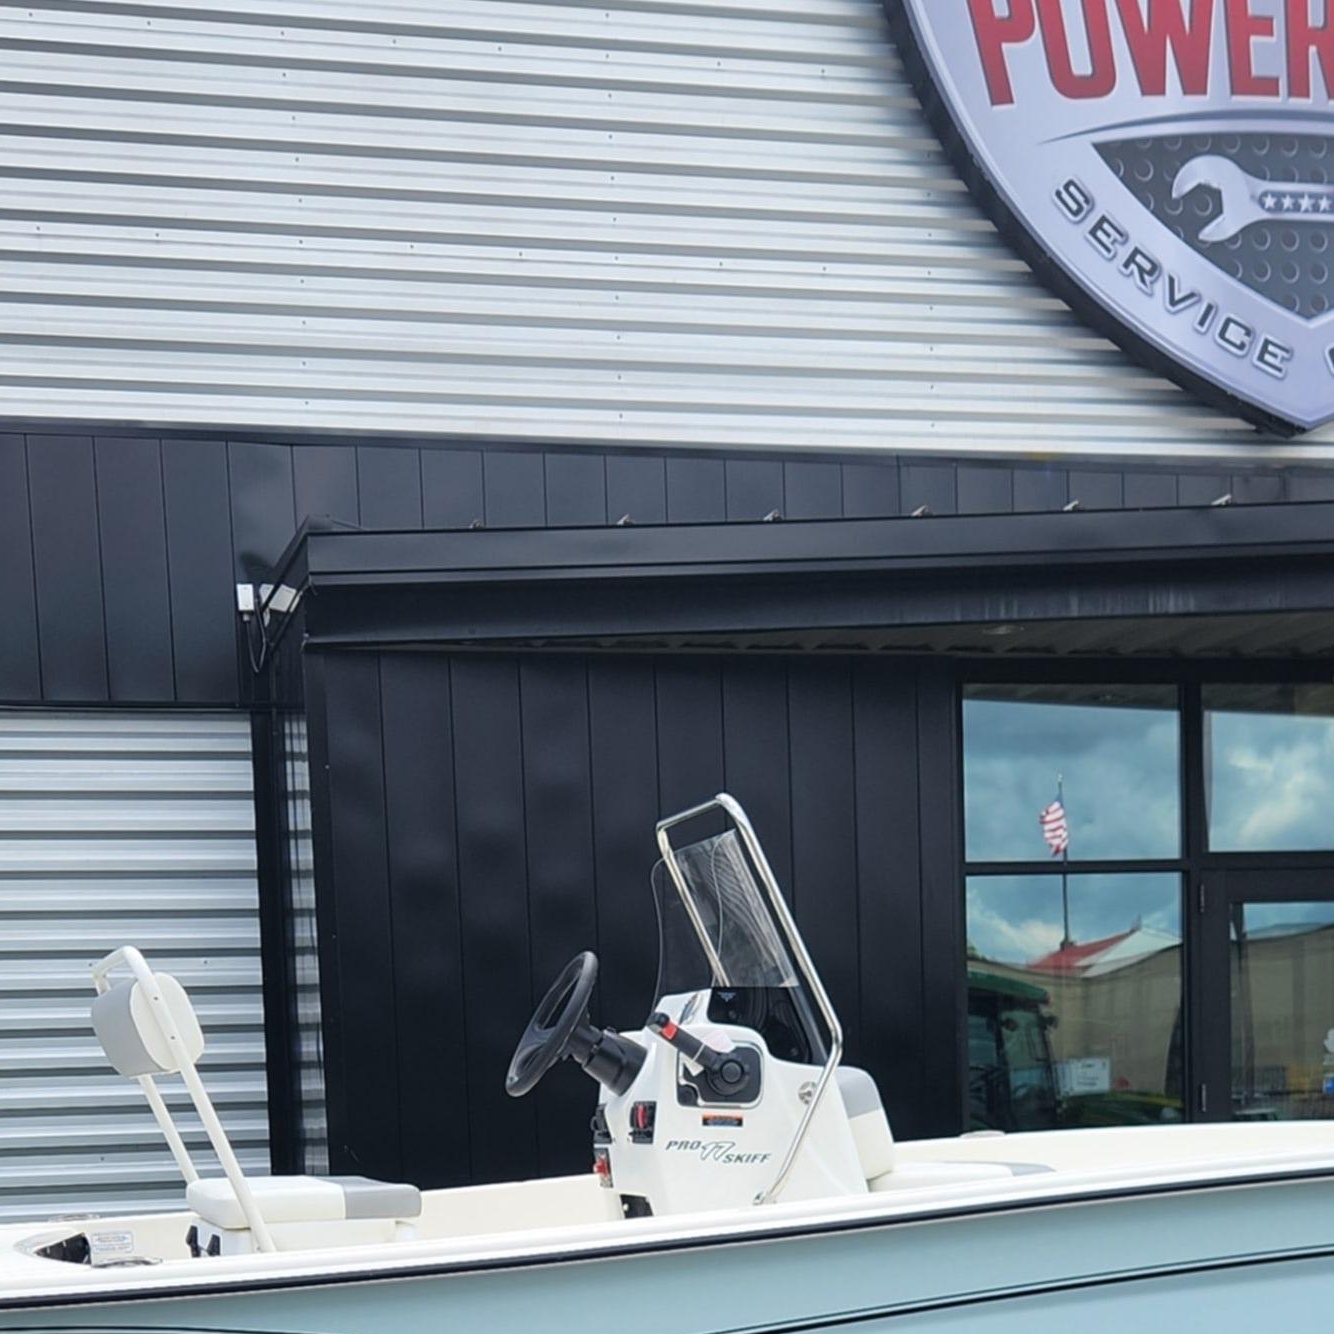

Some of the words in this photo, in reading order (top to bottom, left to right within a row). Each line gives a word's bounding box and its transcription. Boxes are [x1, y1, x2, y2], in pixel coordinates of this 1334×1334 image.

[1053, 177, 1292, 378] SERVICE
[665, 1140, 702, 1150] PRO
[723, 1153, 771, 1164] SKIFF
